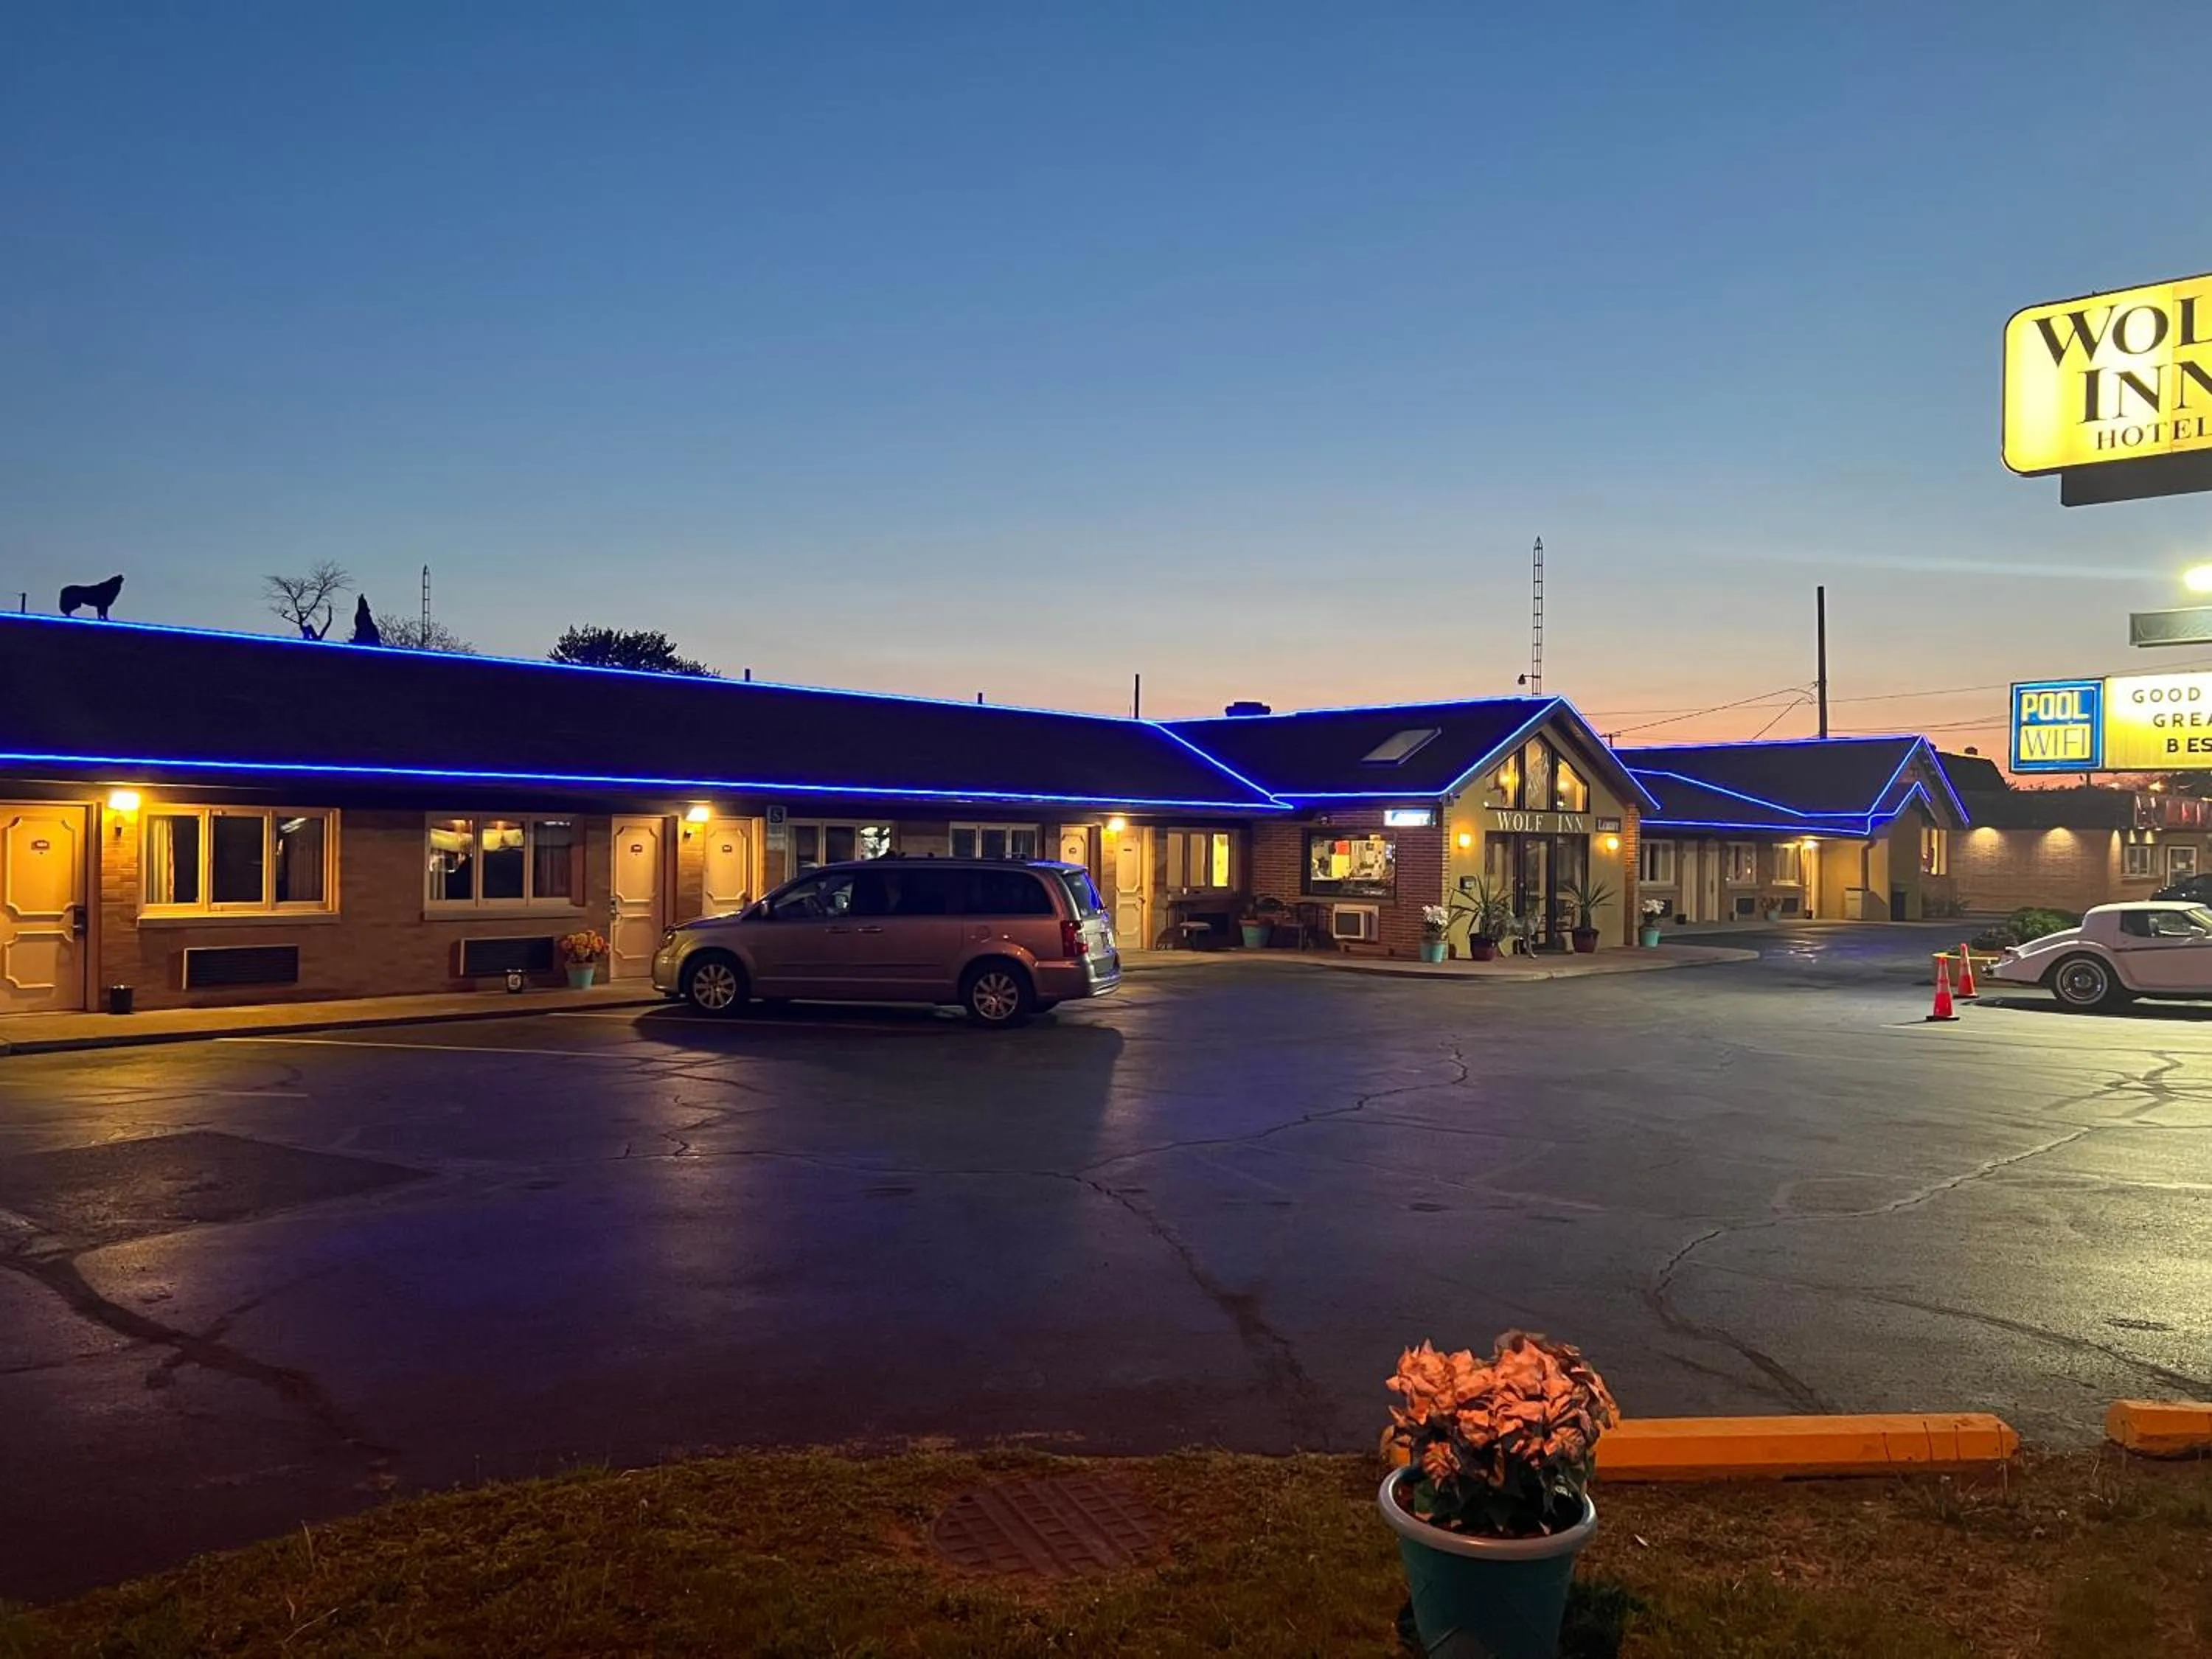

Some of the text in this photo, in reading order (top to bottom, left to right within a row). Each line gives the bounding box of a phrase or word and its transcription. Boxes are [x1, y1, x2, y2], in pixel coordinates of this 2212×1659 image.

[2076, 361, 2212, 425] INN
[2097, 416, 2212, 451] HOTEL
[2021, 691, 2090, 722] POOL
[2132, 686, 2201, 703] GOOD
[2025, 728, 2086, 757] WIFI
[1498, 812, 1543, 832] WOLF
[1558, 813, 1584, 833] INN
